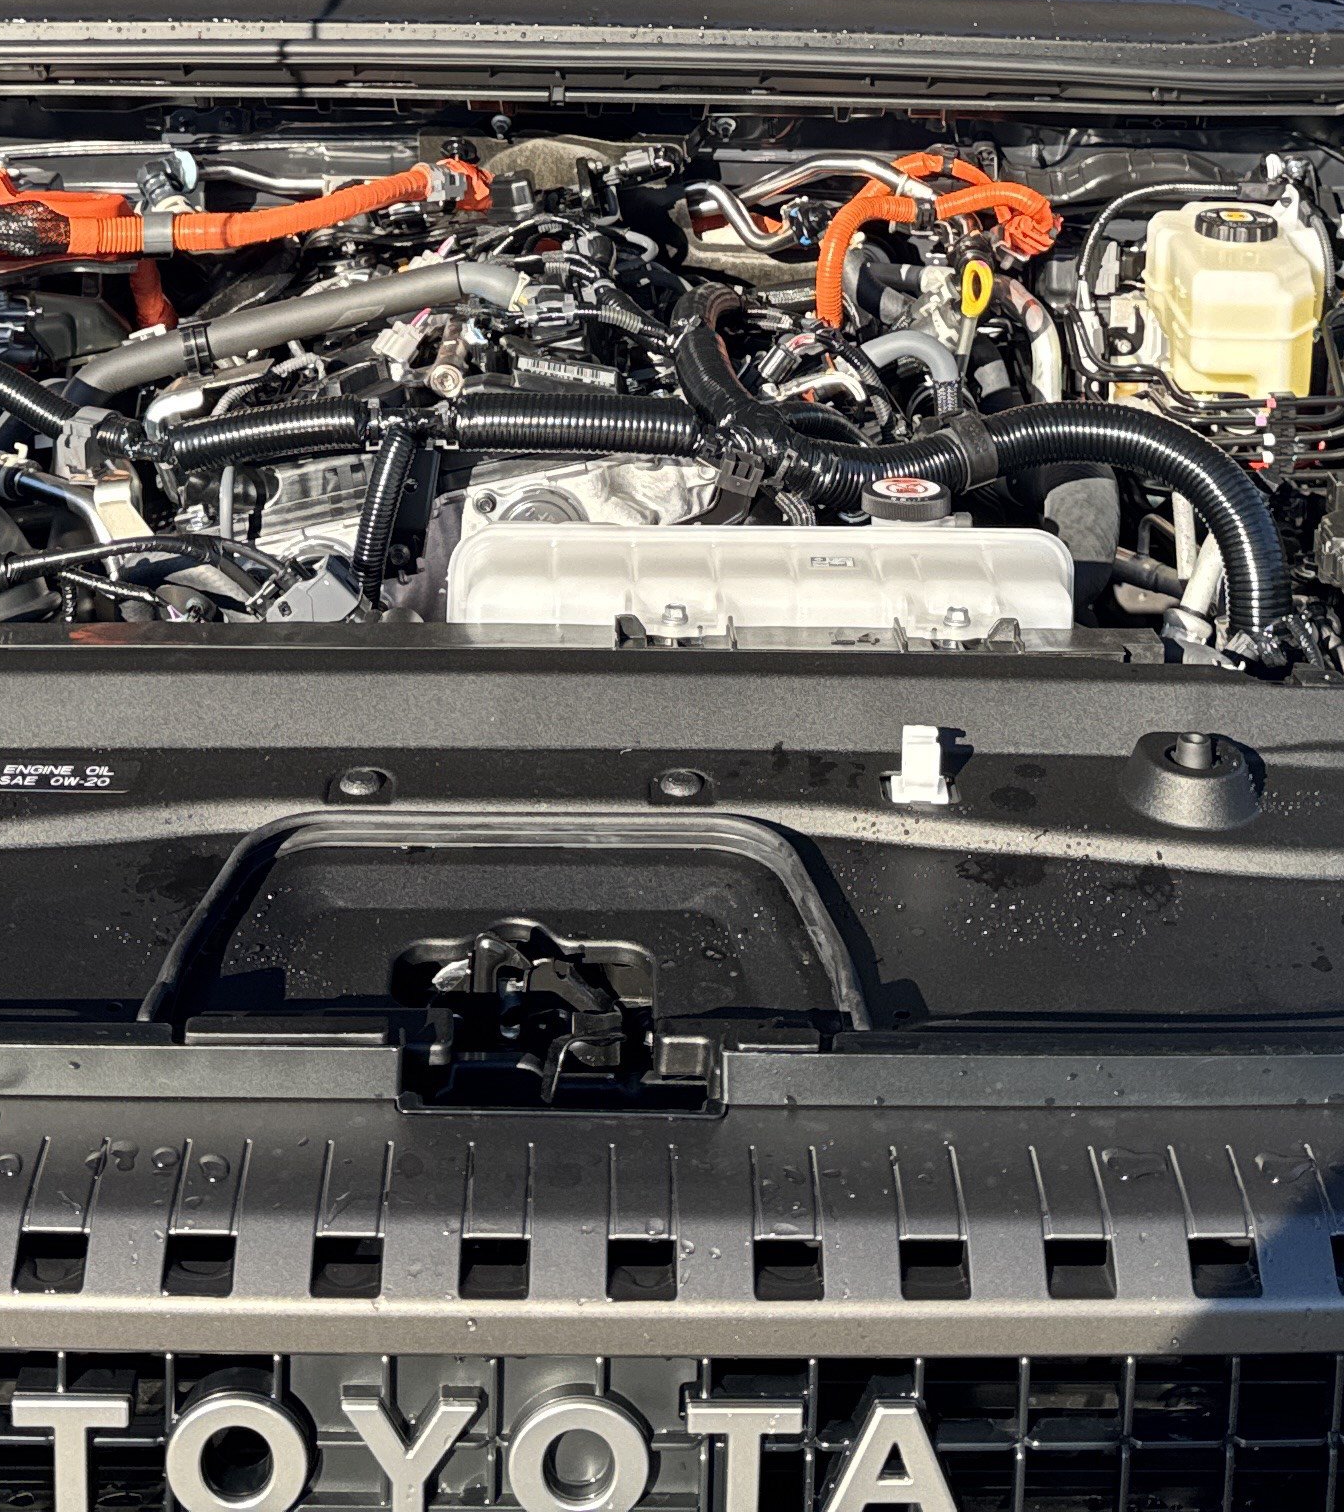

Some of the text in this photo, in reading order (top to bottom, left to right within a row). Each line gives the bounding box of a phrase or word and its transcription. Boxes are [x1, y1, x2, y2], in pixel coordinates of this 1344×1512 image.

[3, 764, 115, 776] ENGINE OIL
[50, 776, 111, 787] 0W-20
[11, 1394, 958, 1512] TOYOTA
